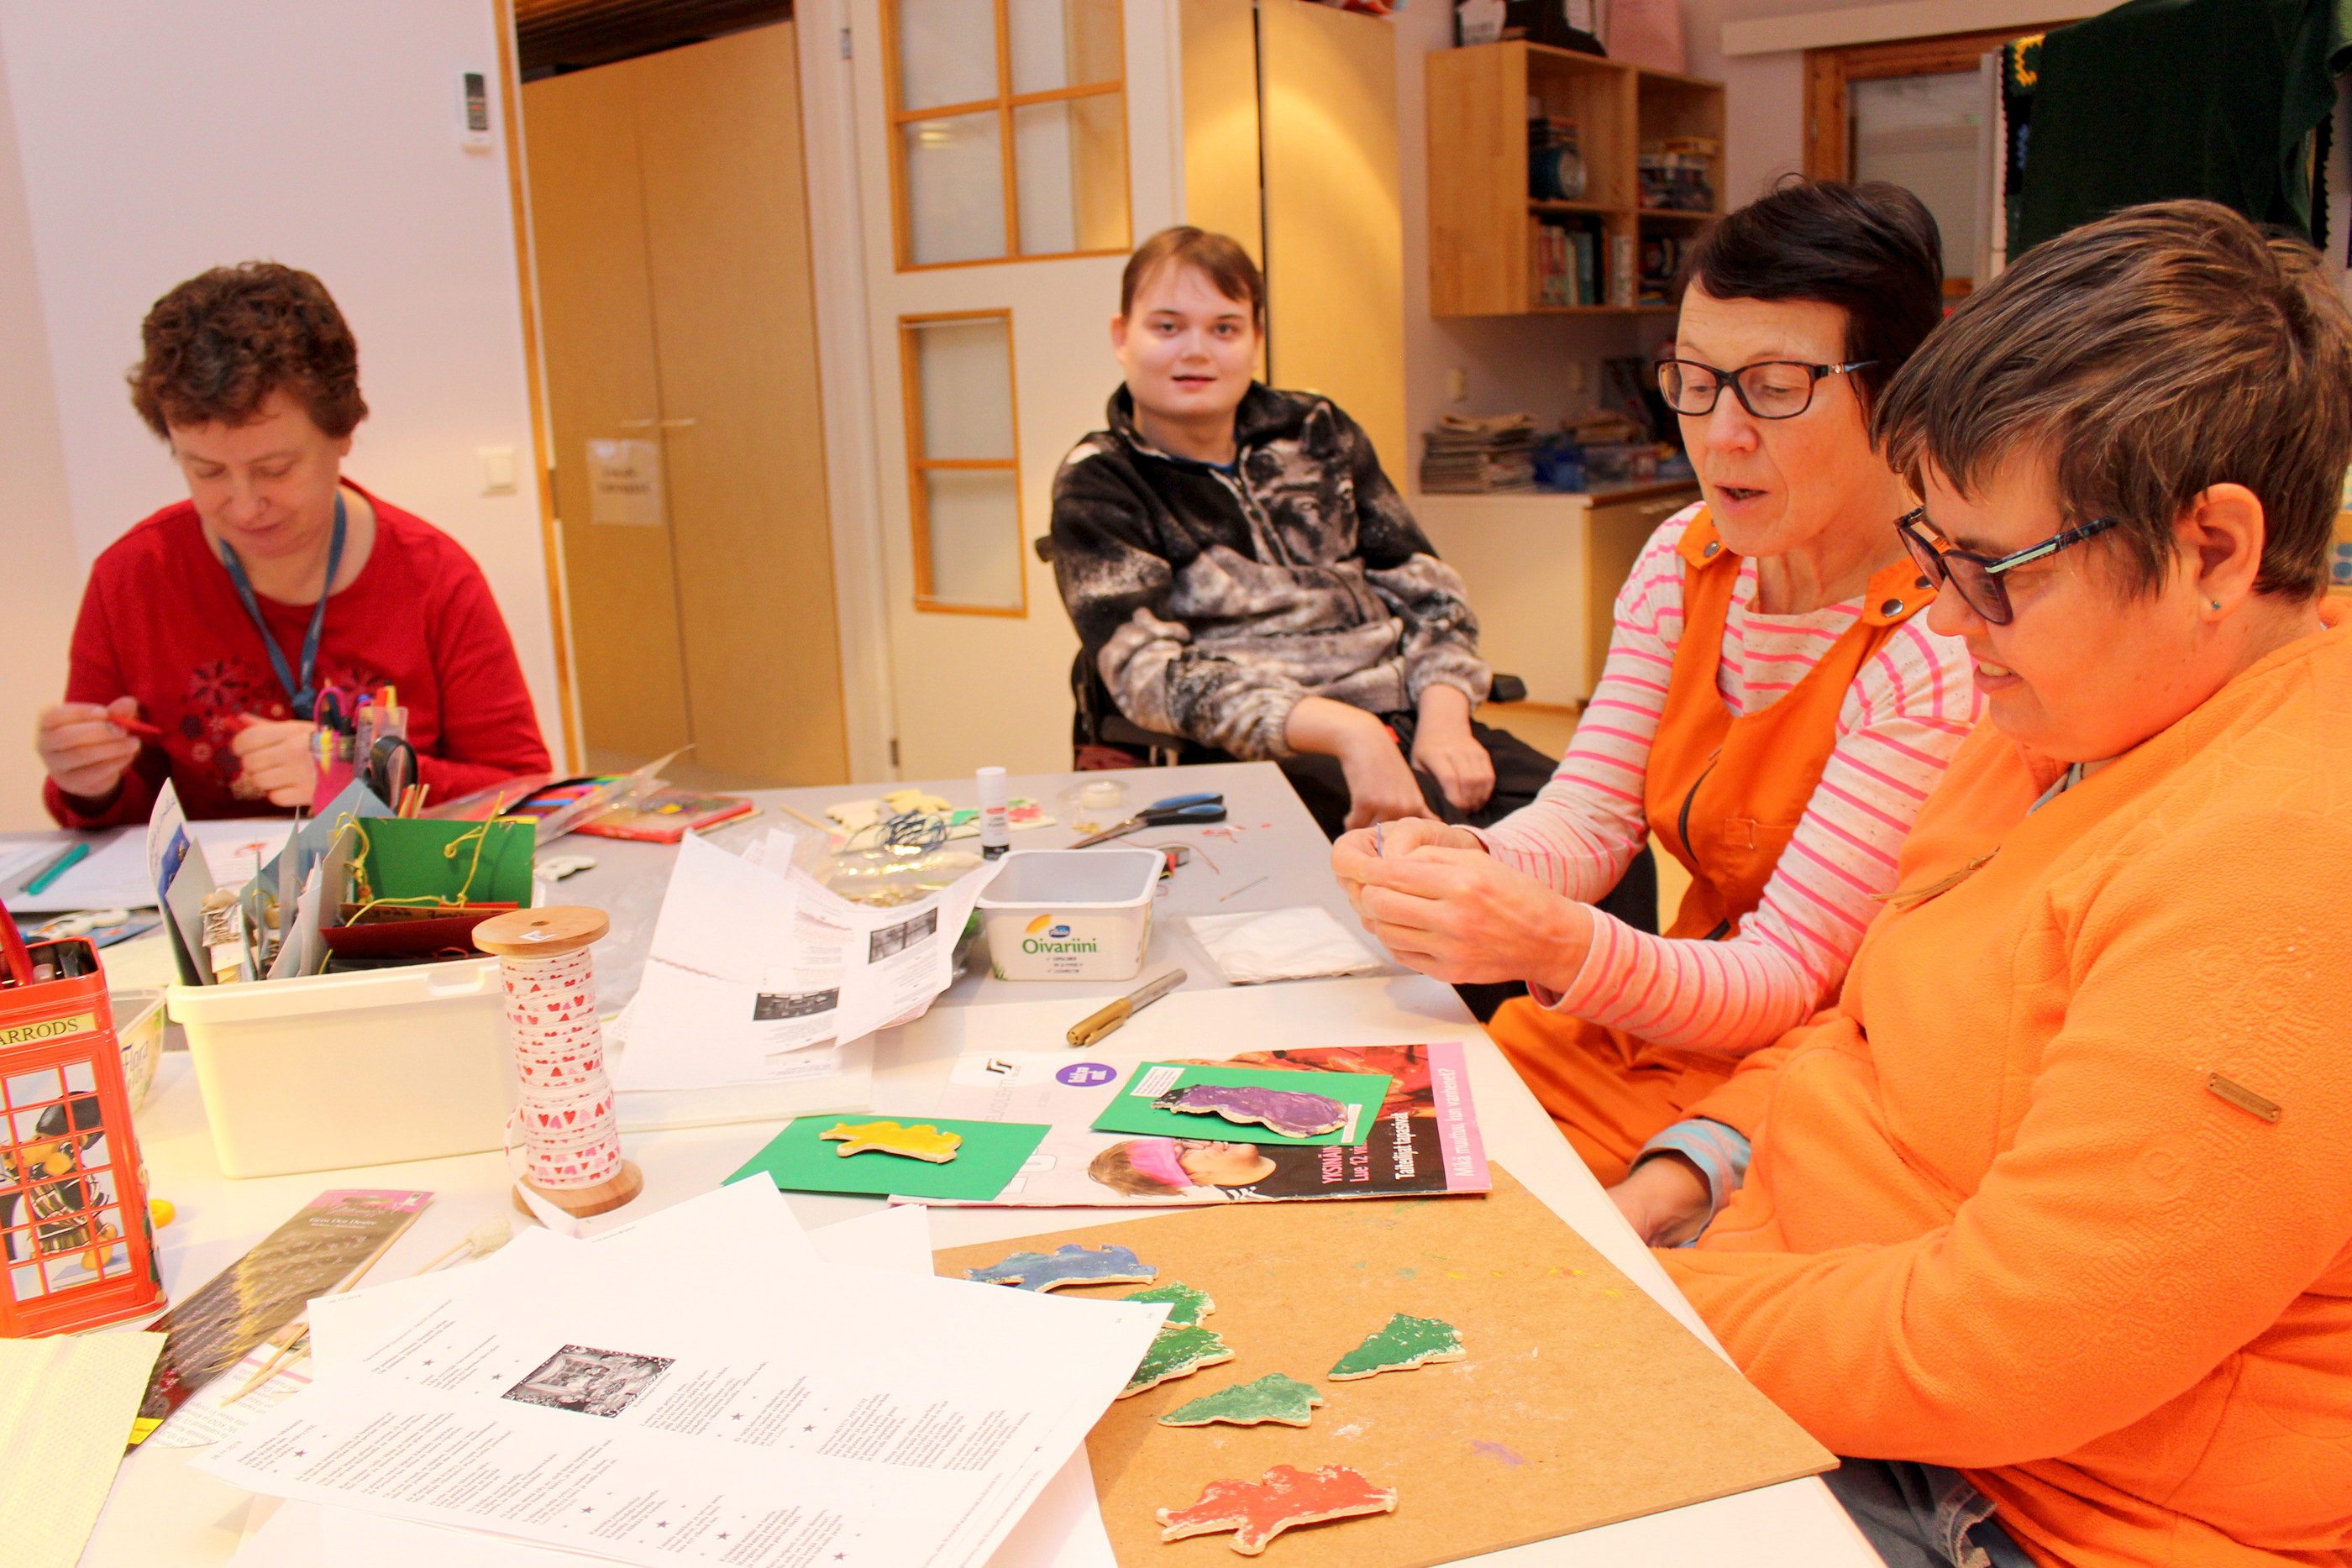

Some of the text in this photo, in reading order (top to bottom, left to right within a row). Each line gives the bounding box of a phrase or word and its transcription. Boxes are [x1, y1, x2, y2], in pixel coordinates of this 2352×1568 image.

[1022, 938, 1097, 954] Oivariini
[1438, 1068, 1460, 1107] vanhenet?
[1445, 1109, 1466, 1121] kun
[1390, 1112, 1417, 1144] tapasivat
[1350, 1156, 1369, 1165] 12
[1452, 1156, 1474, 1177] Mikä
[1350, 1166, 1369, 1183] Lue
